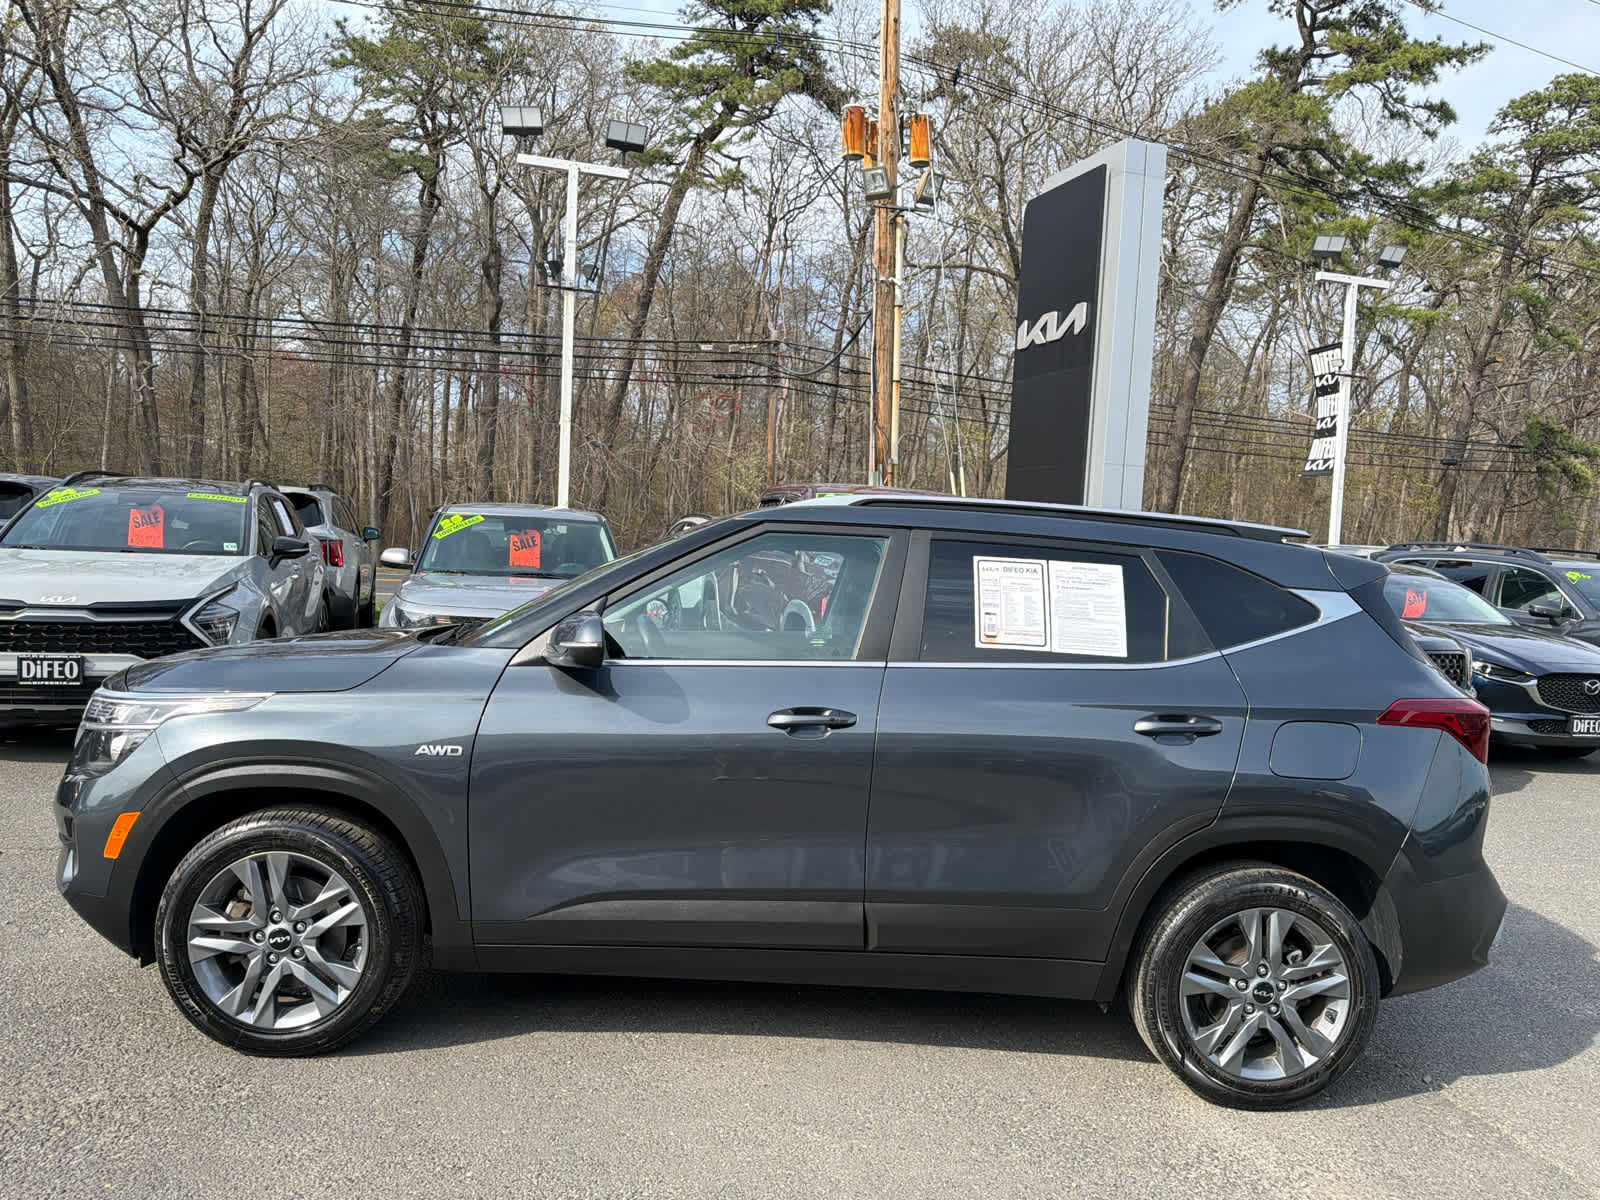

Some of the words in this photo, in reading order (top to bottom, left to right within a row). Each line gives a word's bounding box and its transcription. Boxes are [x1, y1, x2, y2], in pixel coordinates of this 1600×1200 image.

[1016, 302, 1087, 350] KIA
[132, 511, 160, 529] SALE
[512, 535, 538, 552] SALE
[21, 659, 79, 679] DiFEO
[413, 744, 463, 756] AWD
